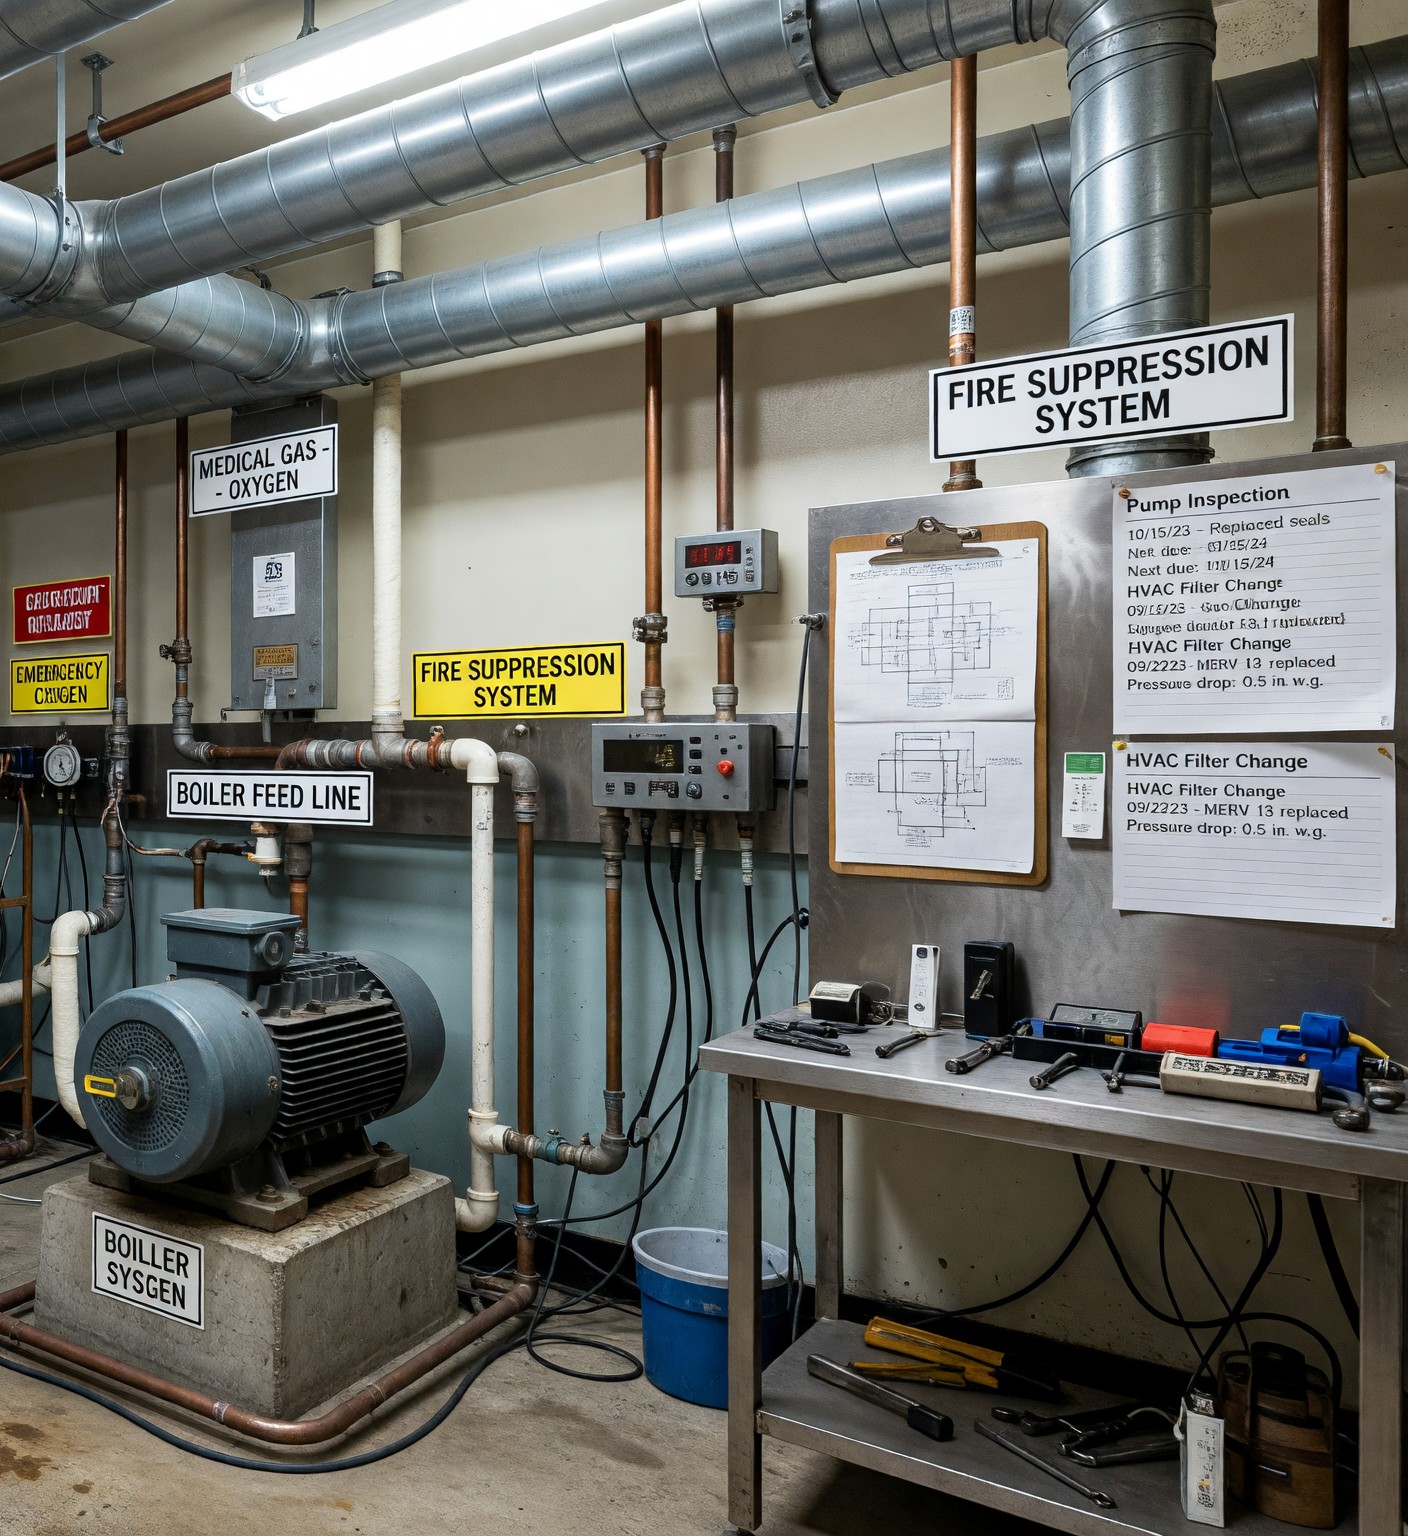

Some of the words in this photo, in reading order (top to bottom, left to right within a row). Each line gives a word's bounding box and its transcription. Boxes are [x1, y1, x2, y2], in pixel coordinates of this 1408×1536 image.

[948, 374, 1015, 410] FIRE
[1027, 335, 1269, 399] SUPPRESSION
[1035, 388, 1170, 434] SYSTEM
[199, 448, 275, 479] MEDICAL
[281, 439, 317, 465] GAS
[229, 469, 299, 500] OXYGEN
[1126, 497, 1182, 514] Pump
[1189, 487, 1290, 510] Inspection
[1128, 524, 1191, 541] 10/15/23
[1289, 513, 1331, 528] seals
[1127, 564, 1161, 578] Next
[1166, 562, 1199, 575] due:
[1127, 582, 1175, 598] HVAC
[1180, 580, 1220, 594] Filter
[1225, 578, 1283, 593] Change
[1128, 639, 1178, 654] HVAC
[1183, 638, 1224, 652] Filter
[1230, 637, 1292, 652] Change
[421, 661, 462, 683] FIRE
[468, 652, 615, 681] SUPPRESSION
[1197, 658, 1238, 671] MERV
[1269, 655, 1336, 671] replaced
[474, 684, 557, 708] SYSTEM
[1196, 676, 1236, 692] drop:
[1242, 675, 1267, 688] 0.5
[1293, 675, 1324, 691] w.g.
[1126, 753, 1179, 768] HVAC
[1185, 754, 1230, 768] Filter
[1235, 754, 1308, 773] Change
[177, 781, 246, 807] BOILER
[252, 783, 304, 809] FEED
[312, 785, 361, 811] LINE
[1127, 782, 1173, 796] HVAC
[1179, 783, 1219, 797] Filter
[1224, 784, 1286, 800] Change
[1204, 804, 1250, 817] MERV
[1257, 805, 1274, 818] 13
[1280, 806, 1349, 823] replaced
[1126, 819, 1193, 834] Pressure
[1197, 820, 1237, 837] drop:
[1242, 823, 1266, 836] 0.5
[1272, 824, 1290, 837] in.
[1295, 826, 1327, 840] w.g.
[105, 1228, 189, 1279] BOILLER
[107, 1261, 186, 1310] SYSGEN
